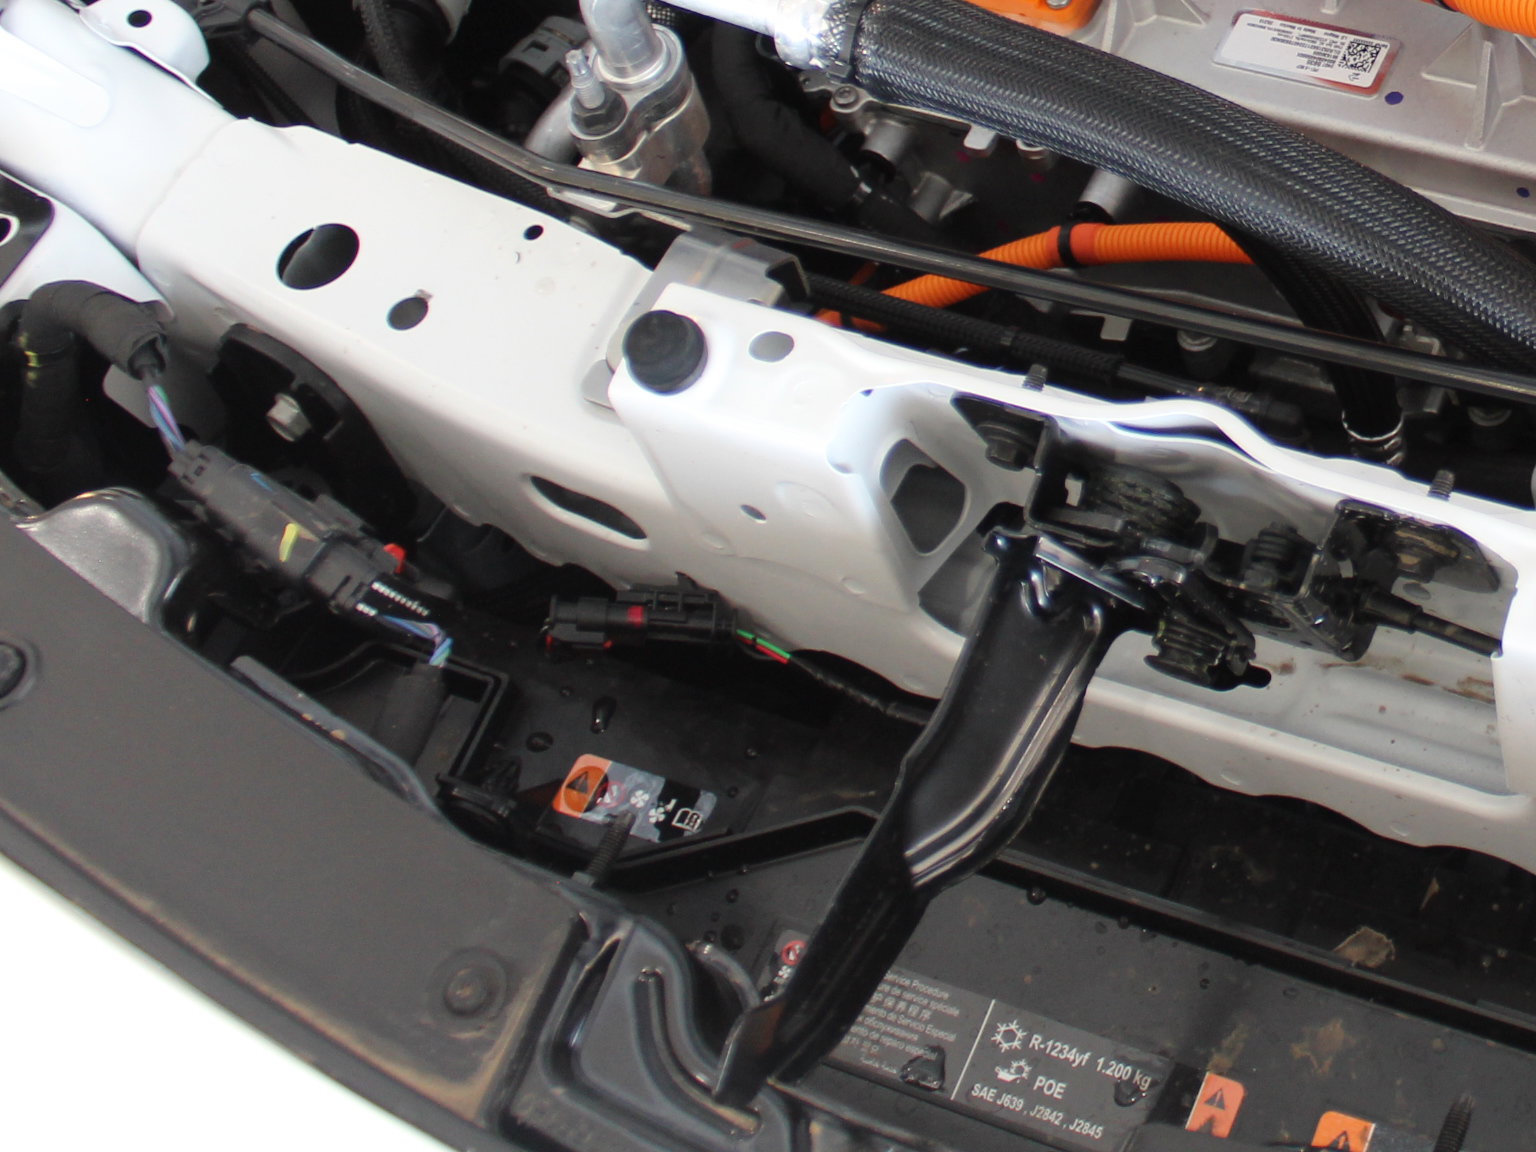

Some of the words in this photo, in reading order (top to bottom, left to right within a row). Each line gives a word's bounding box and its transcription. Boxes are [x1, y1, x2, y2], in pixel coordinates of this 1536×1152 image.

[1029, 1034, 1091, 1068] R-1234yf
[1096, 1057, 1133, 1081] 1.200
[1133, 1069, 1153, 1091] kg
[1033, 1076, 1066, 1099] POE
[971, 1083, 997, 1103] SAE
[1069, 1119, 1104, 1139] J2845
